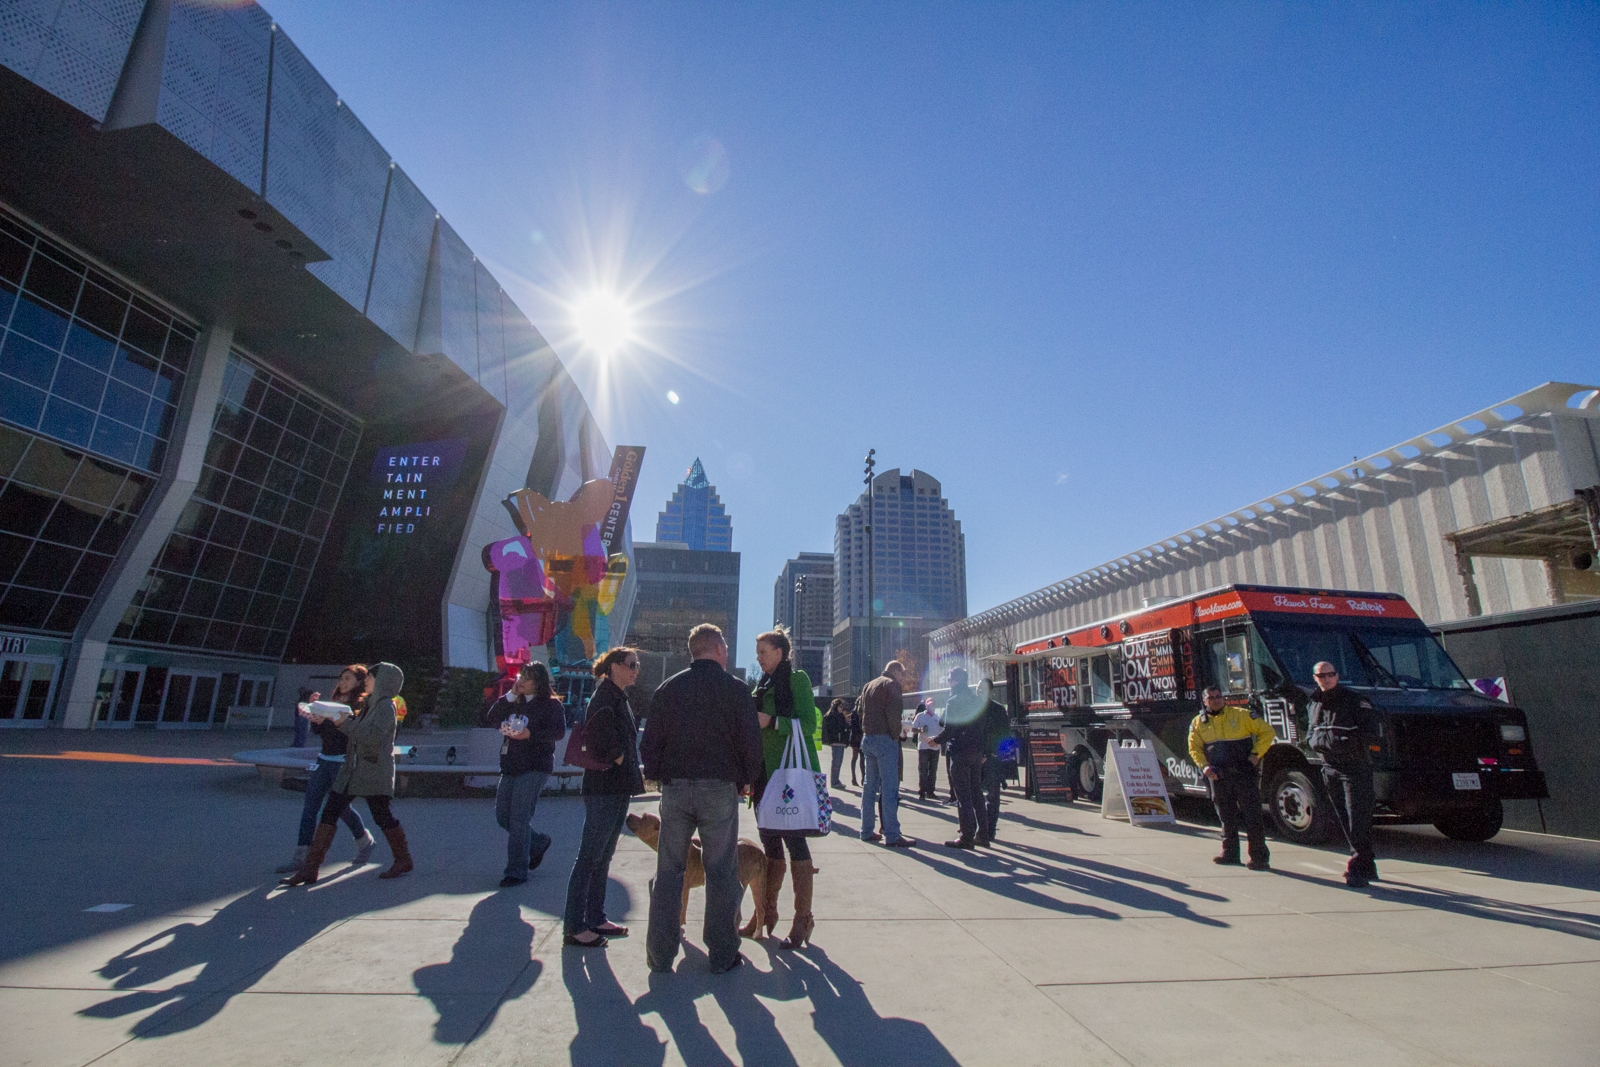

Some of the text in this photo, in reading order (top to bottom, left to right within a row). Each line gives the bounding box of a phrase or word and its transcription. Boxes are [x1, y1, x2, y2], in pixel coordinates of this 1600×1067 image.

[388, 456, 441, 466] ENTER
[386, 473, 423, 483] TAIN
[616, 451, 638, 494] Golden
[383, 489, 427, 500] MENT
[379, 506, 430, 517] AMPLI
[377, 523, 415, 534] FIED
[602, 502, 621, 547] CENTER
[1273, 595, 1309, 608] Flavor
[1309, 597, 1335, 609] Face
[1051, 656, 1075, 670] FOOD
[1183, 643, 1195, 690] BOLD
